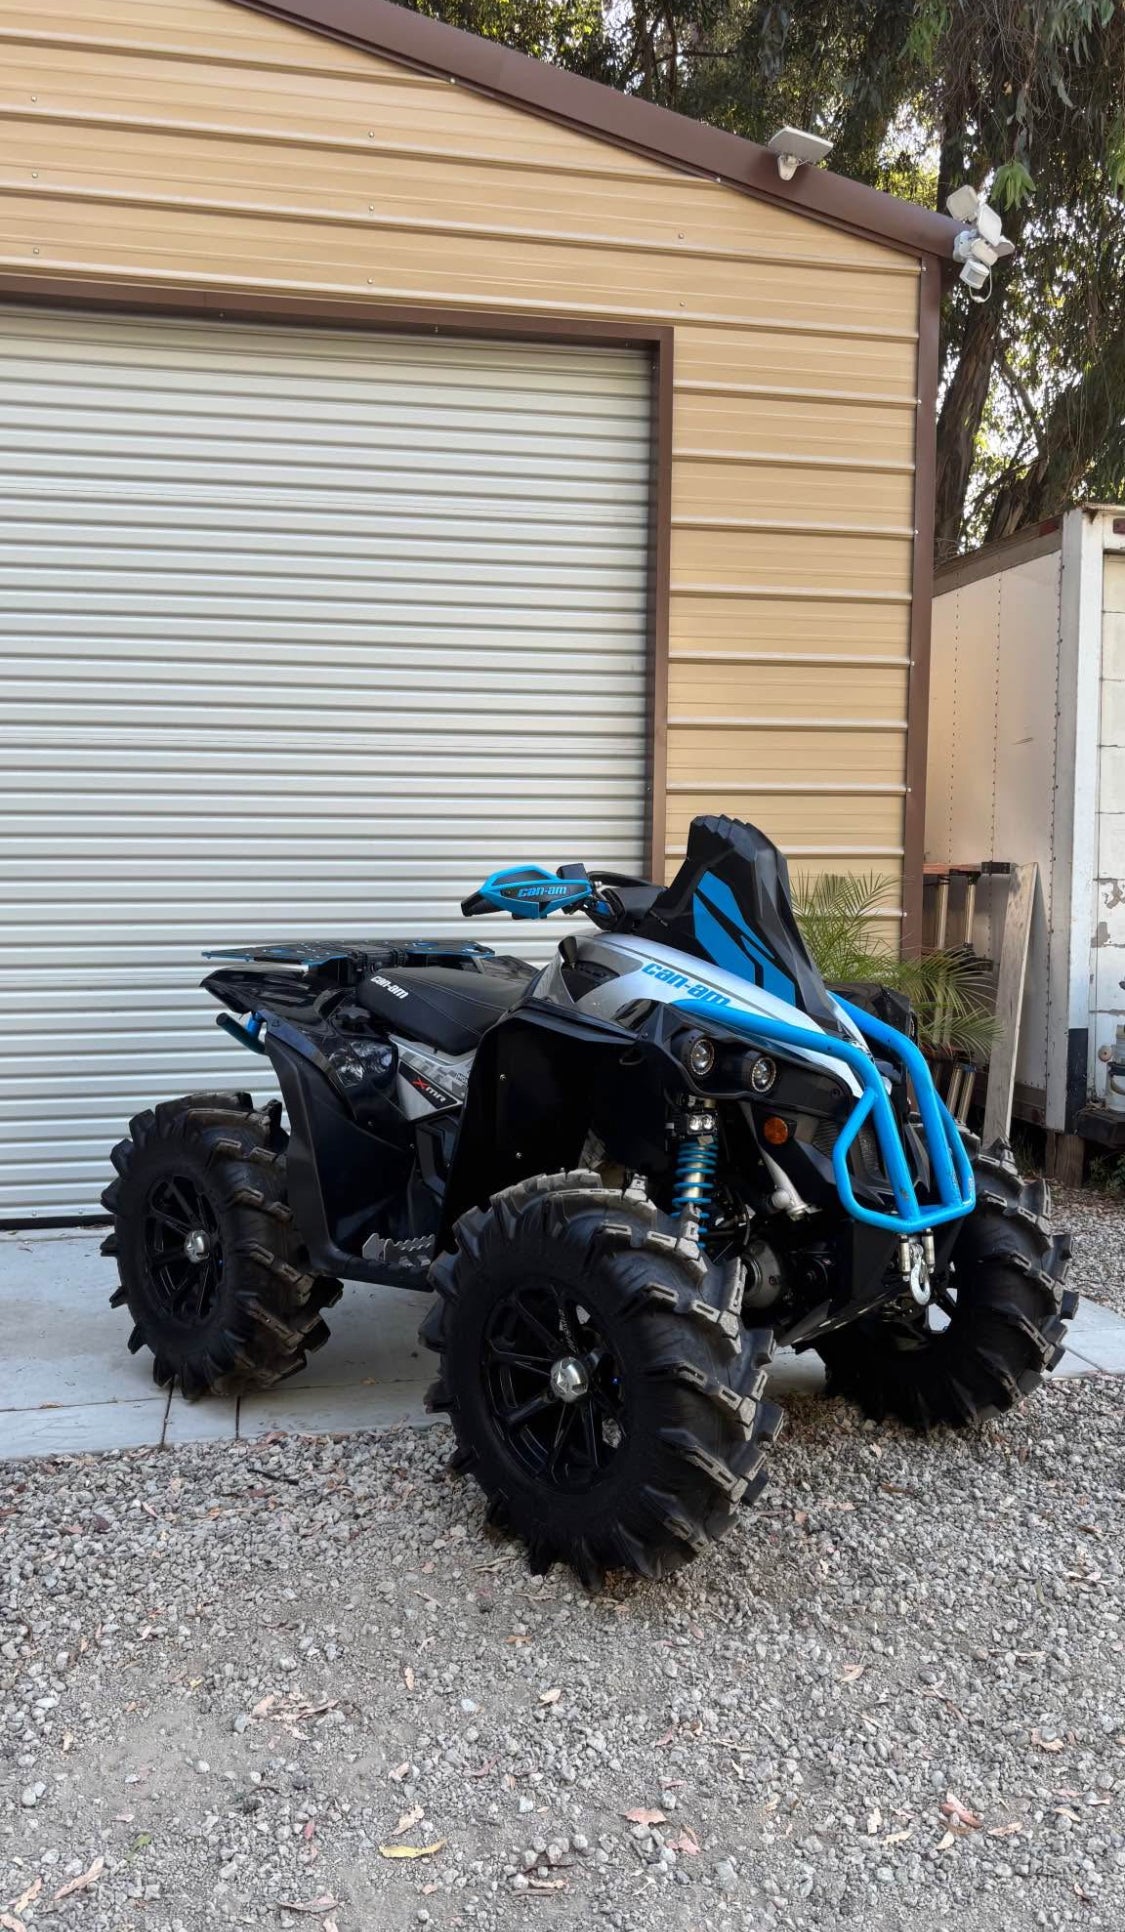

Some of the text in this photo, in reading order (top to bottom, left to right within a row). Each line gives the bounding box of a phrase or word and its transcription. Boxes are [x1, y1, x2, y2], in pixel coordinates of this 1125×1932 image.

[518, 886, 567, 898] can-am
[370, 975, 409, 999] can-am
[642, 963, 731, 1006] can-am
